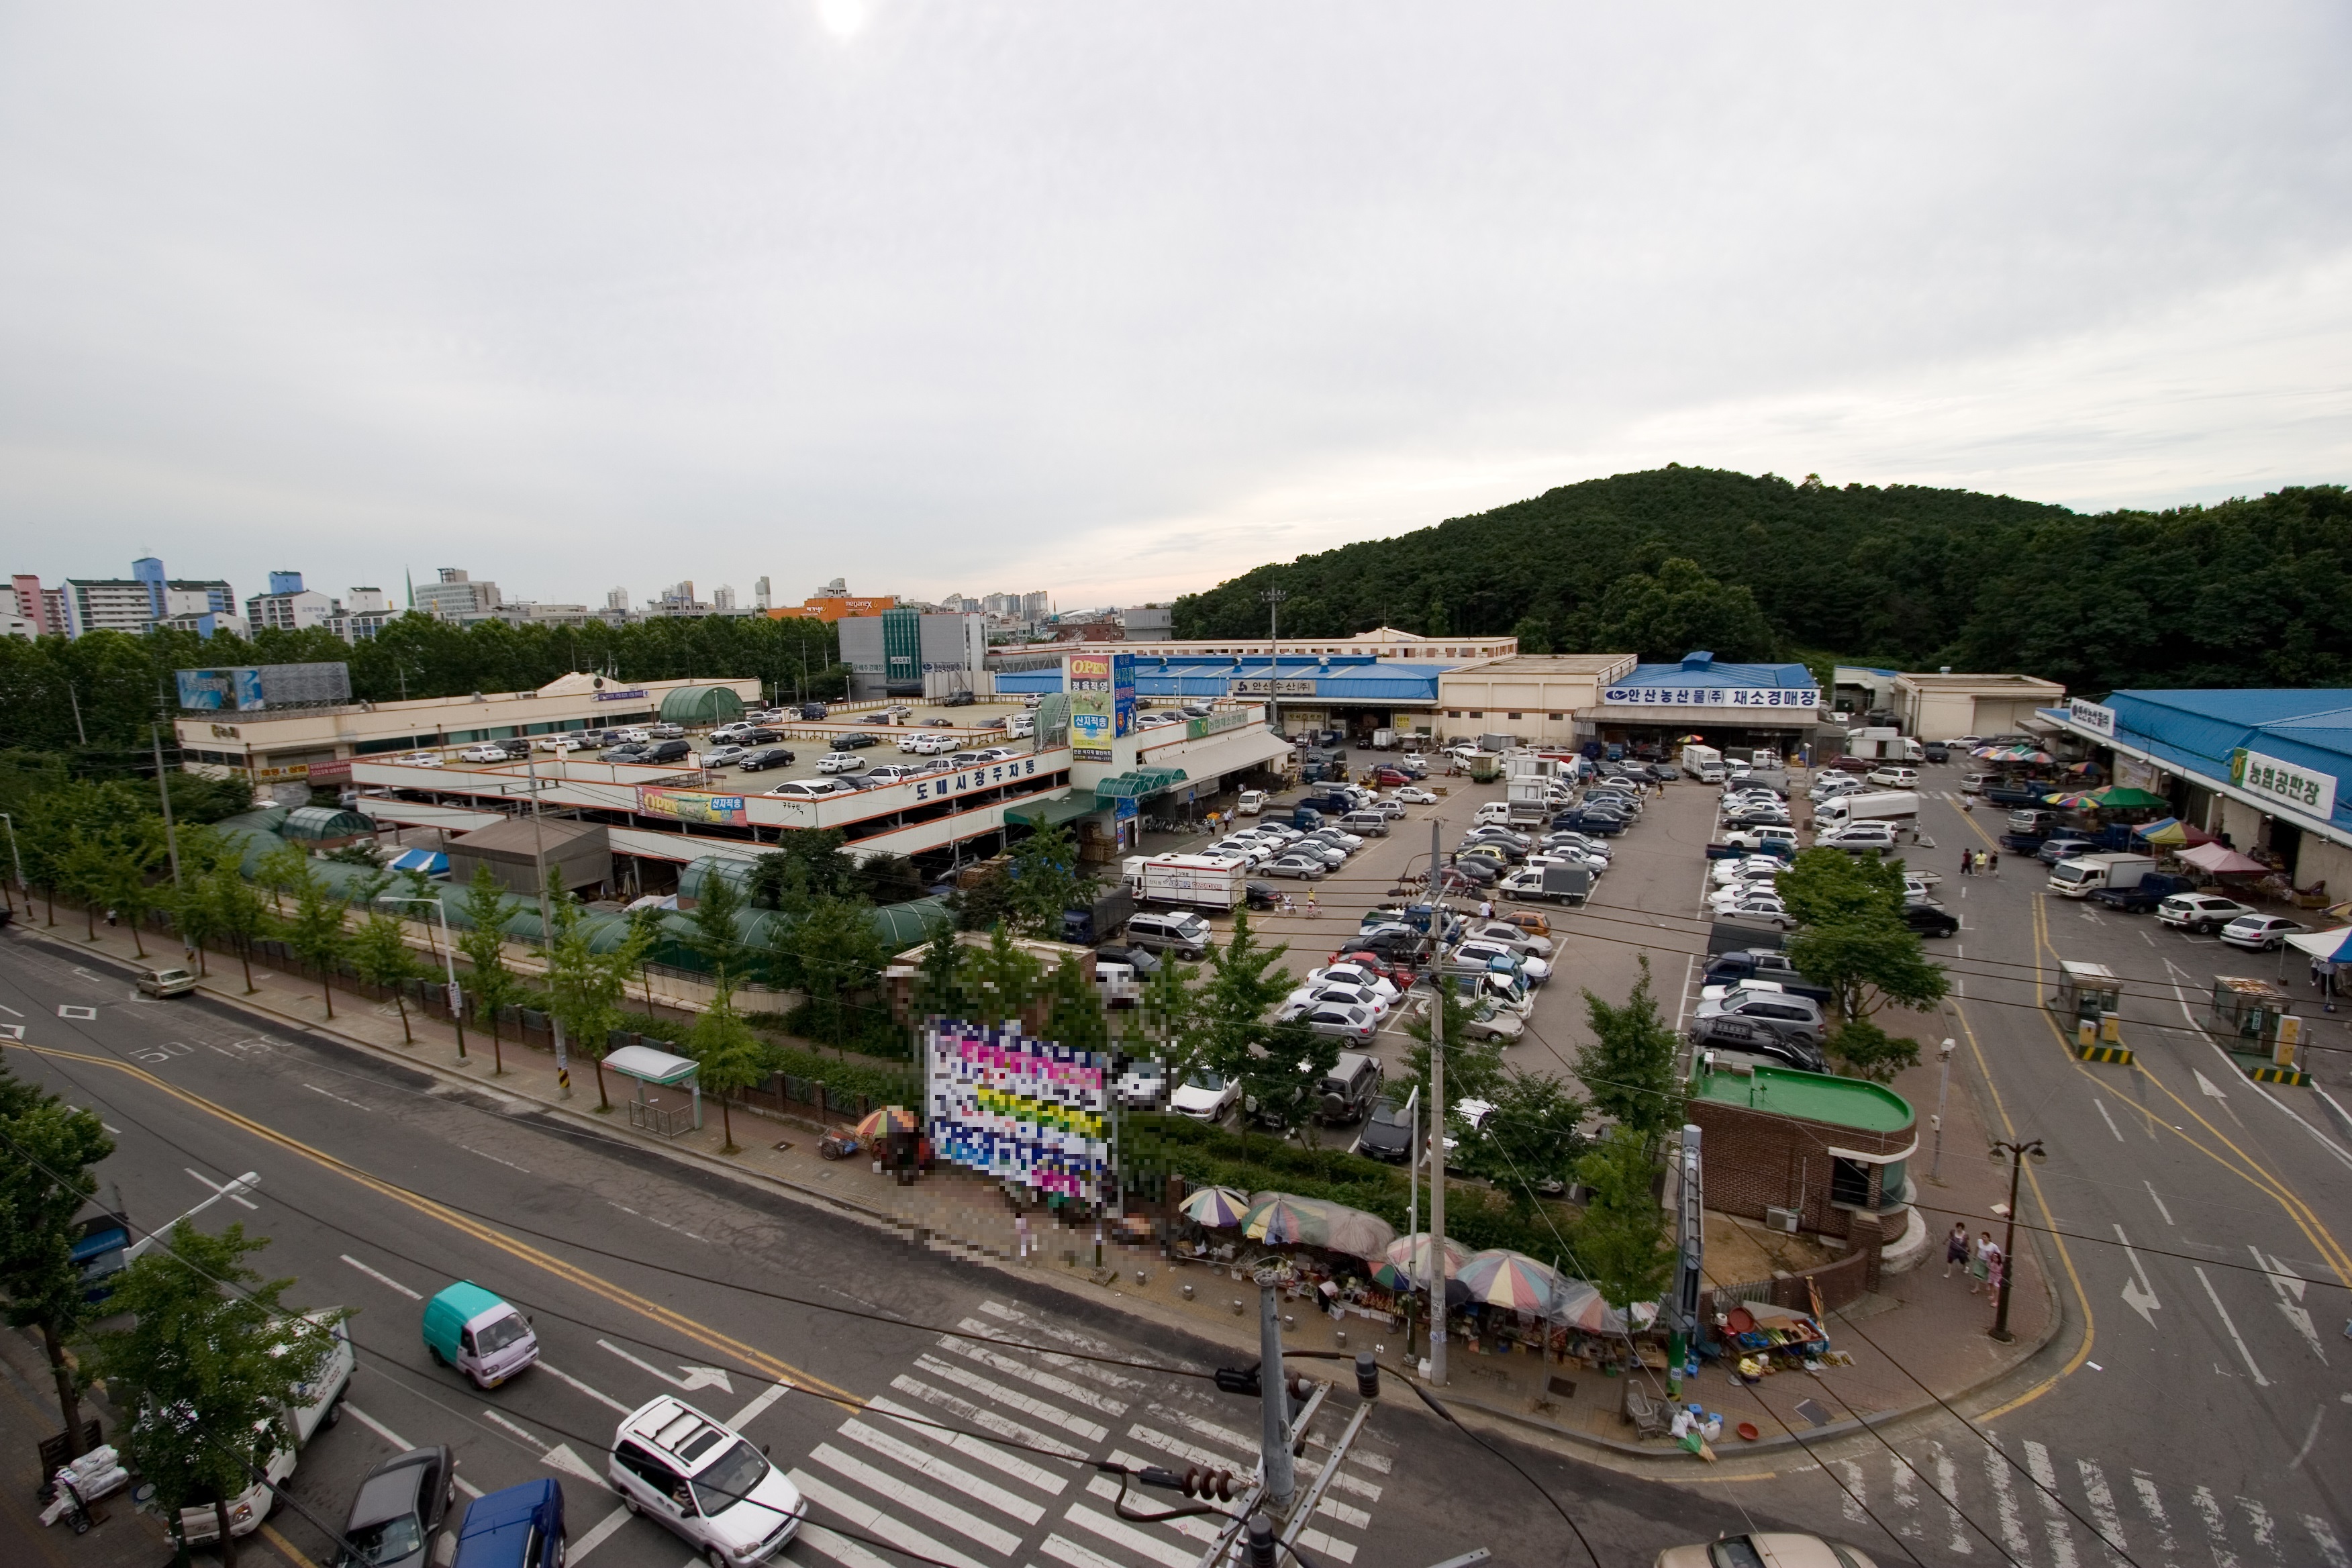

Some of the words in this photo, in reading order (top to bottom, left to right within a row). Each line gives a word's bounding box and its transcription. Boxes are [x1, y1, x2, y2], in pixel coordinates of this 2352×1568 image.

[1071, 659, 1108, 675] OPEN
[1073, 681, 1108, 692] 정육직영
[1628, 689, 1724, 703] 안산농산물(주)
[1734, 690, 1816, 706] 채소경매장
[1075, 716, 1106, 728] 산지직송
[917, 759, 1034, 801] 도매시장주차동
[2249, 762, 2320, 805] 농협공판장
[644, 793, 678, 816] OPEN
[712, 797, 742, 809] 산지직송
